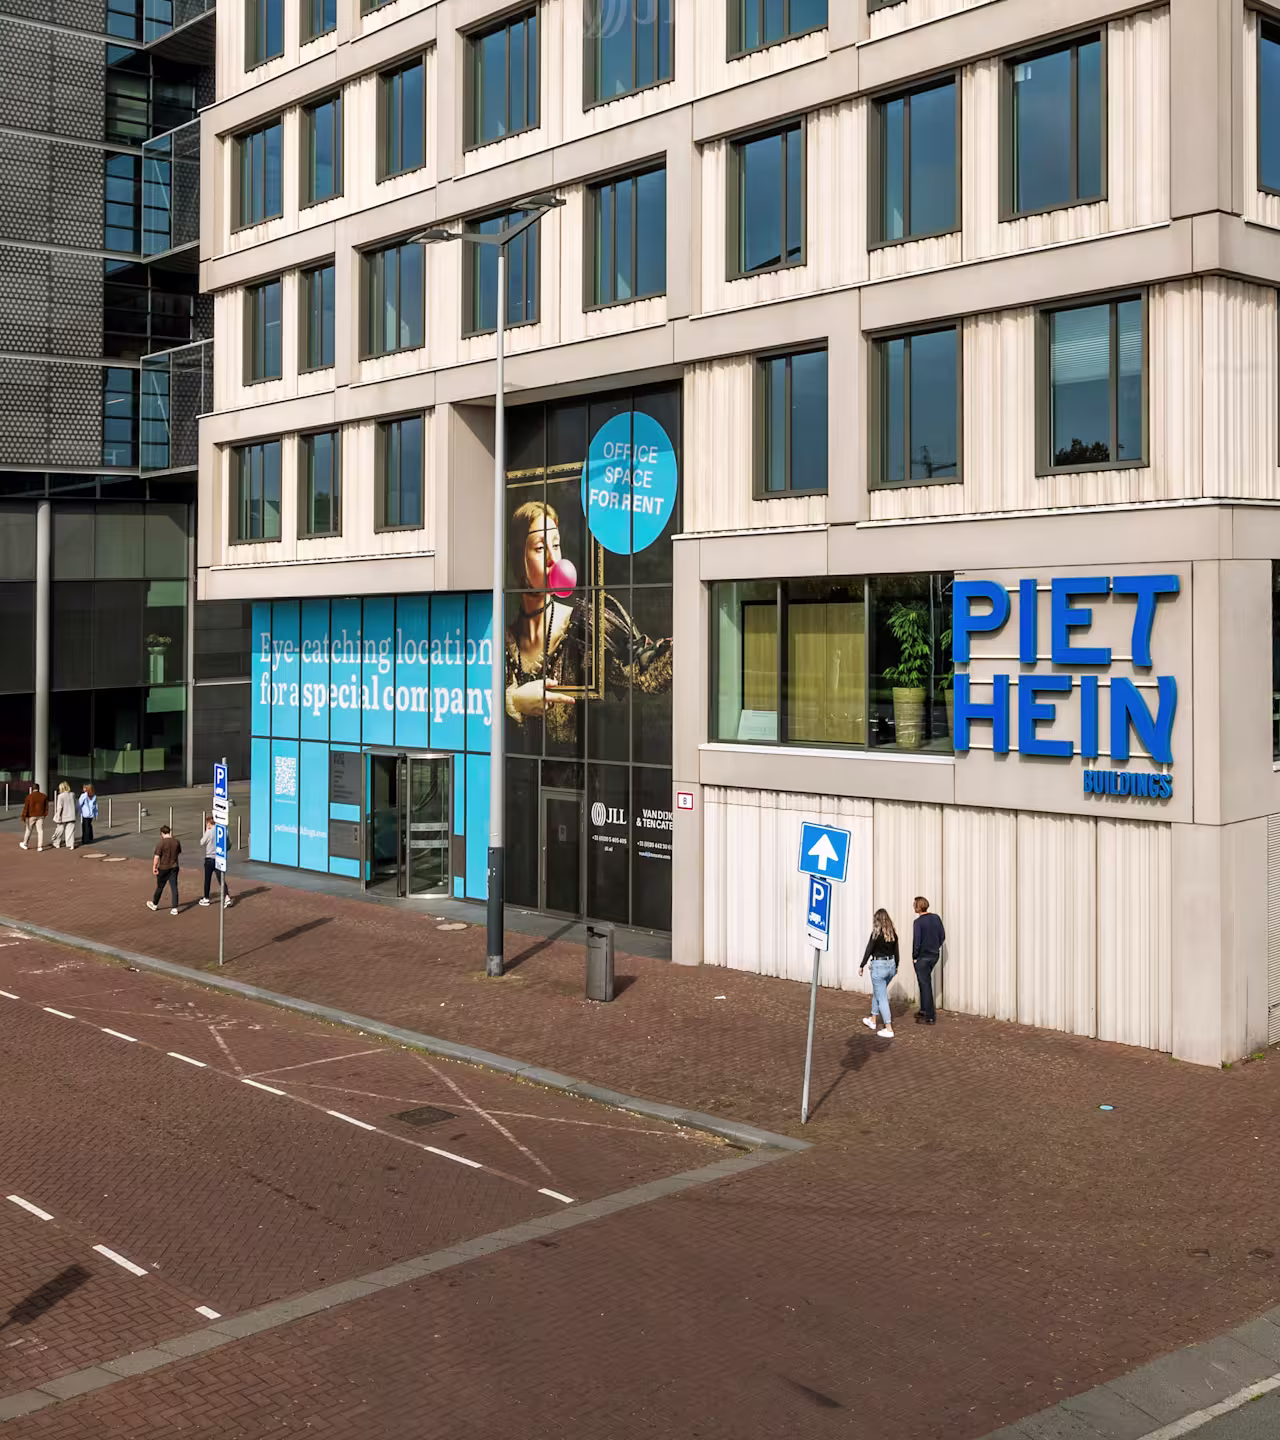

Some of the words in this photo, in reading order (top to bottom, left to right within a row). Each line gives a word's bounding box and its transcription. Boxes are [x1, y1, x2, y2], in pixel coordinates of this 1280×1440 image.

[603, 441, 658, 465] OFFICE
[604, 466, 653, 489] SPACE
[589, 488, 619, 510] FOR
[621, 493, 665, 516] RENT
[952, 574, 1181, 667] PIET
[259, 629, 392, 674] Eye-catching
[396, 628, 493, 665] location
[259, 672, 291, 706] for
[290, 682, 300, 707] a
[302, 673, 380, 717] special
[382, 684, 493, 727] company
[953, 672, 1178, 764] HEIN
[216, 767, 225, 785] P
[1083, 769, 1173, 799] BUILDINGS
[606, 807, 627, 825] JLL
[636, 817, 642, 827] &
[642, 818, 656, 829] TEN
[656, 819, 674, 831] CATE
[642, 808, 657, 820] VAN
[216, 826, 224, 843] P
[811, 880, 825, 908] P
